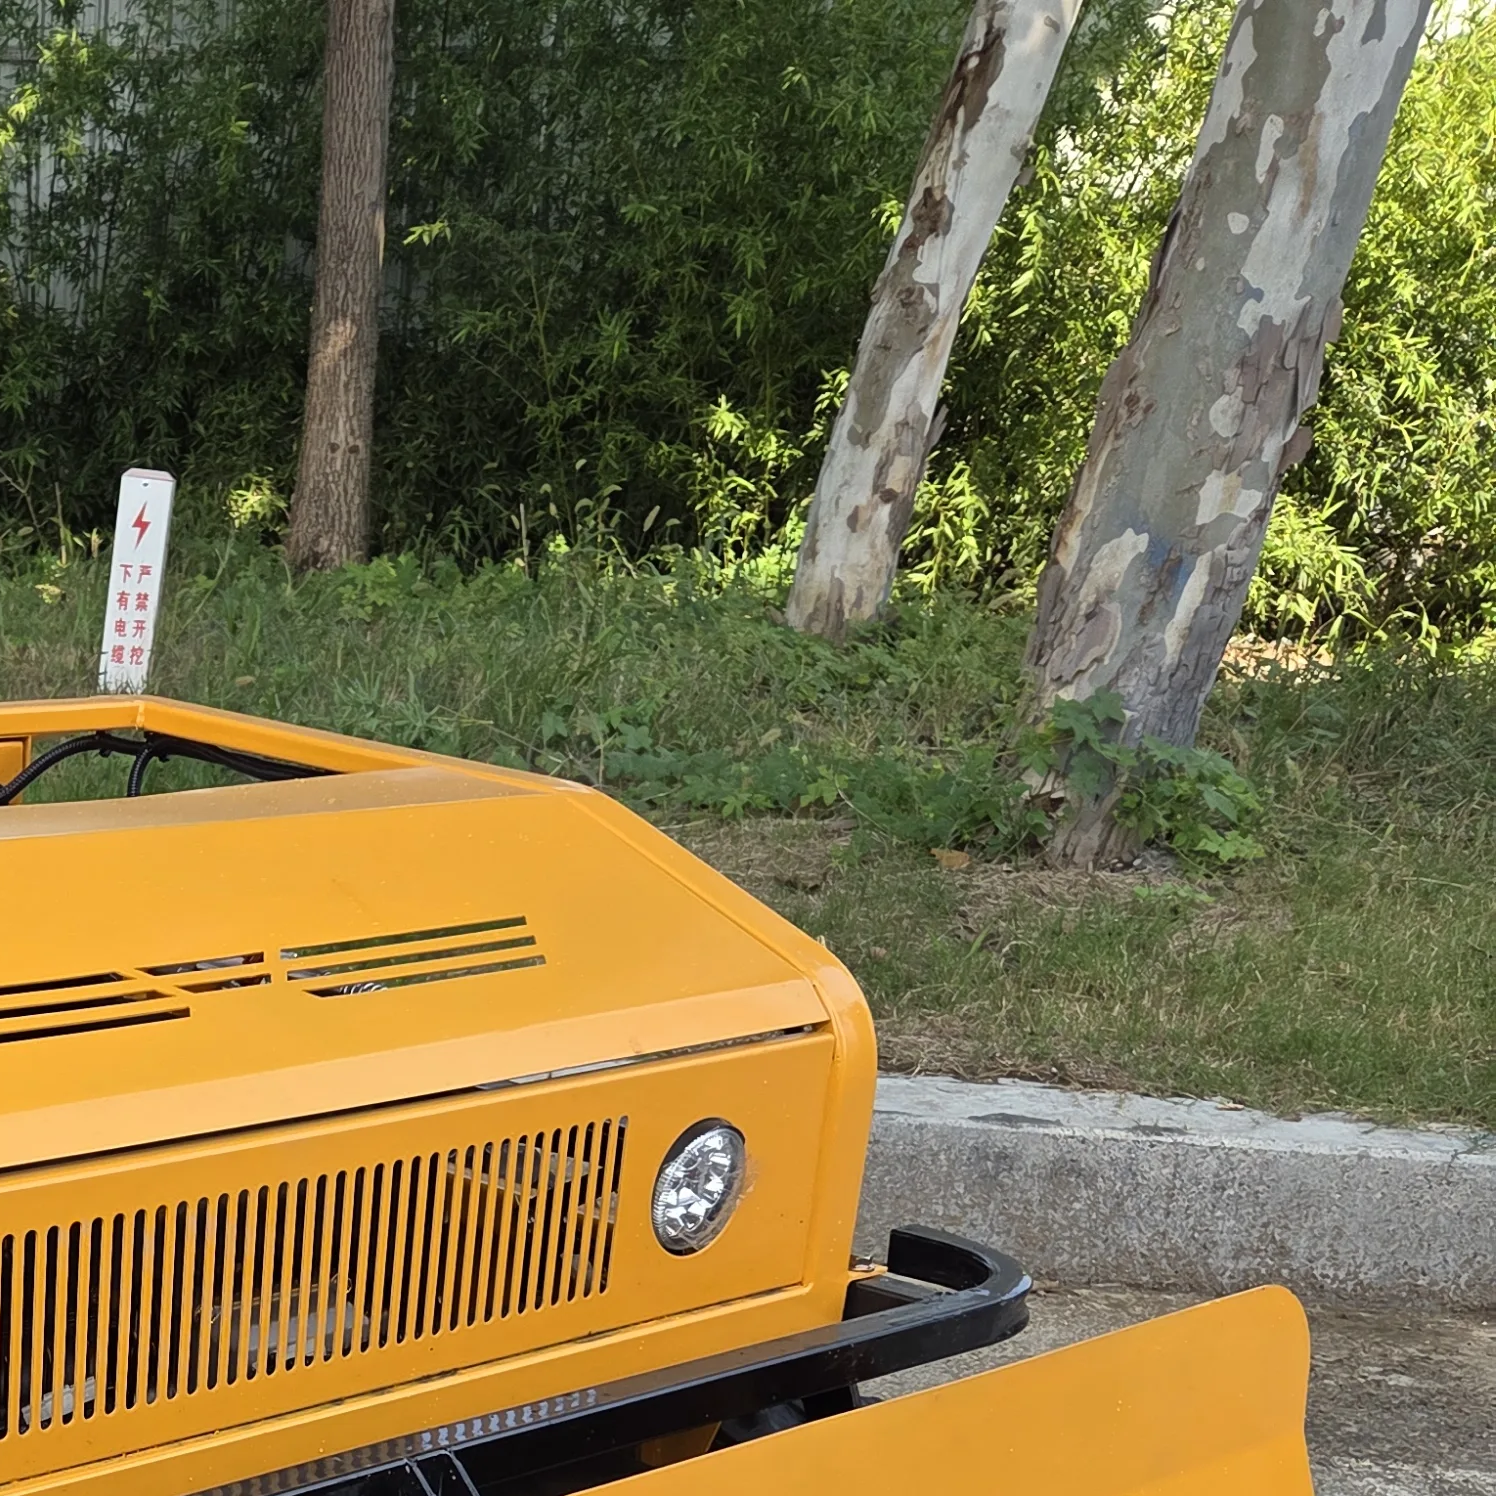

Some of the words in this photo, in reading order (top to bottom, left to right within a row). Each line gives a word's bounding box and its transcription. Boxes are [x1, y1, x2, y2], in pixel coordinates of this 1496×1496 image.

[110, 563, 134, 665] 下有电缆
[129, 564, 153, 666] 严禁开挖
